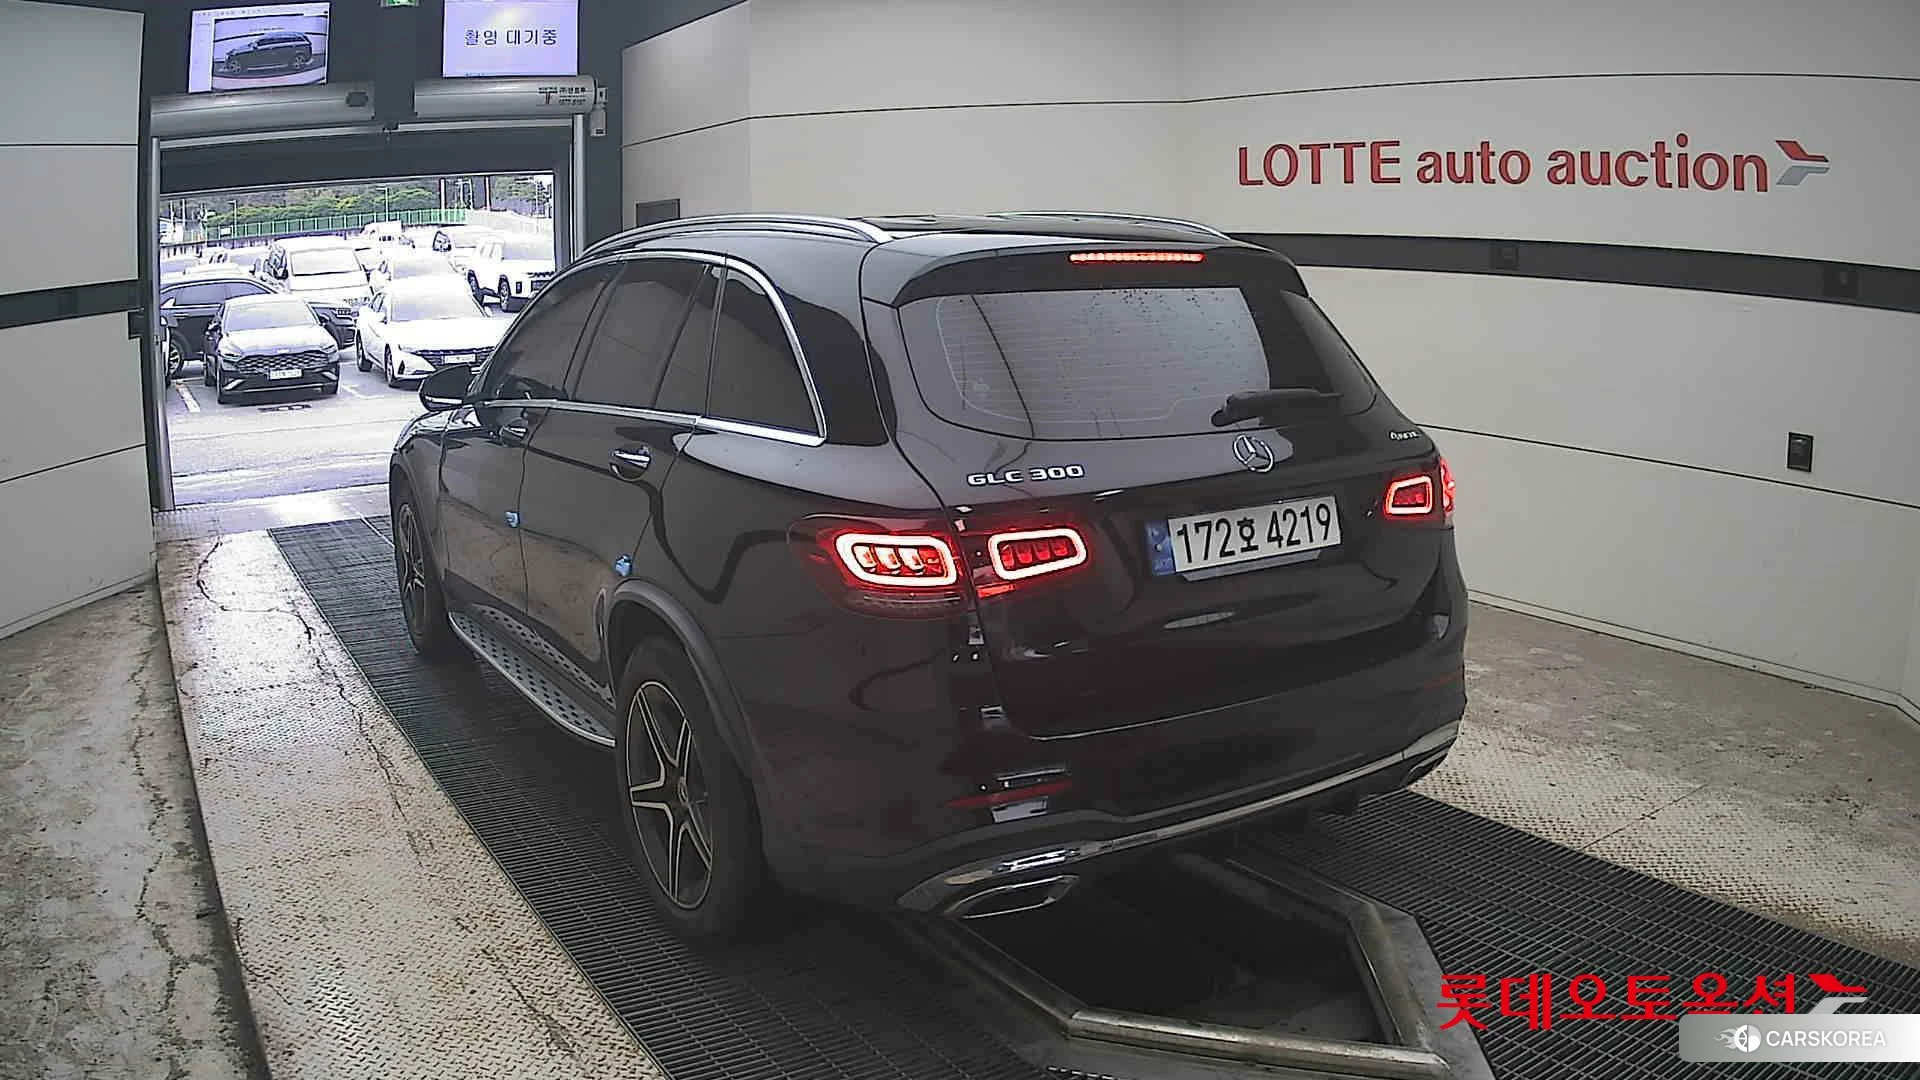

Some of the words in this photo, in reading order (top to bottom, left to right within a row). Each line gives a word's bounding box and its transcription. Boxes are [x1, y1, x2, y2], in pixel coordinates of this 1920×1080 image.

[505, 29, 558, 46] 대기중
[1238, 140, 1400, 187] LOTTE
[1416, 141, 1531, 185] auto
[1546, 132, 1768, 193] auction
[967, 472, 1024, 486] GLC
[1029, 464, 1085, 480] 300
[1176, 517, 1259, 563] 172호
[1266, 503, 1331, 549] 4219
